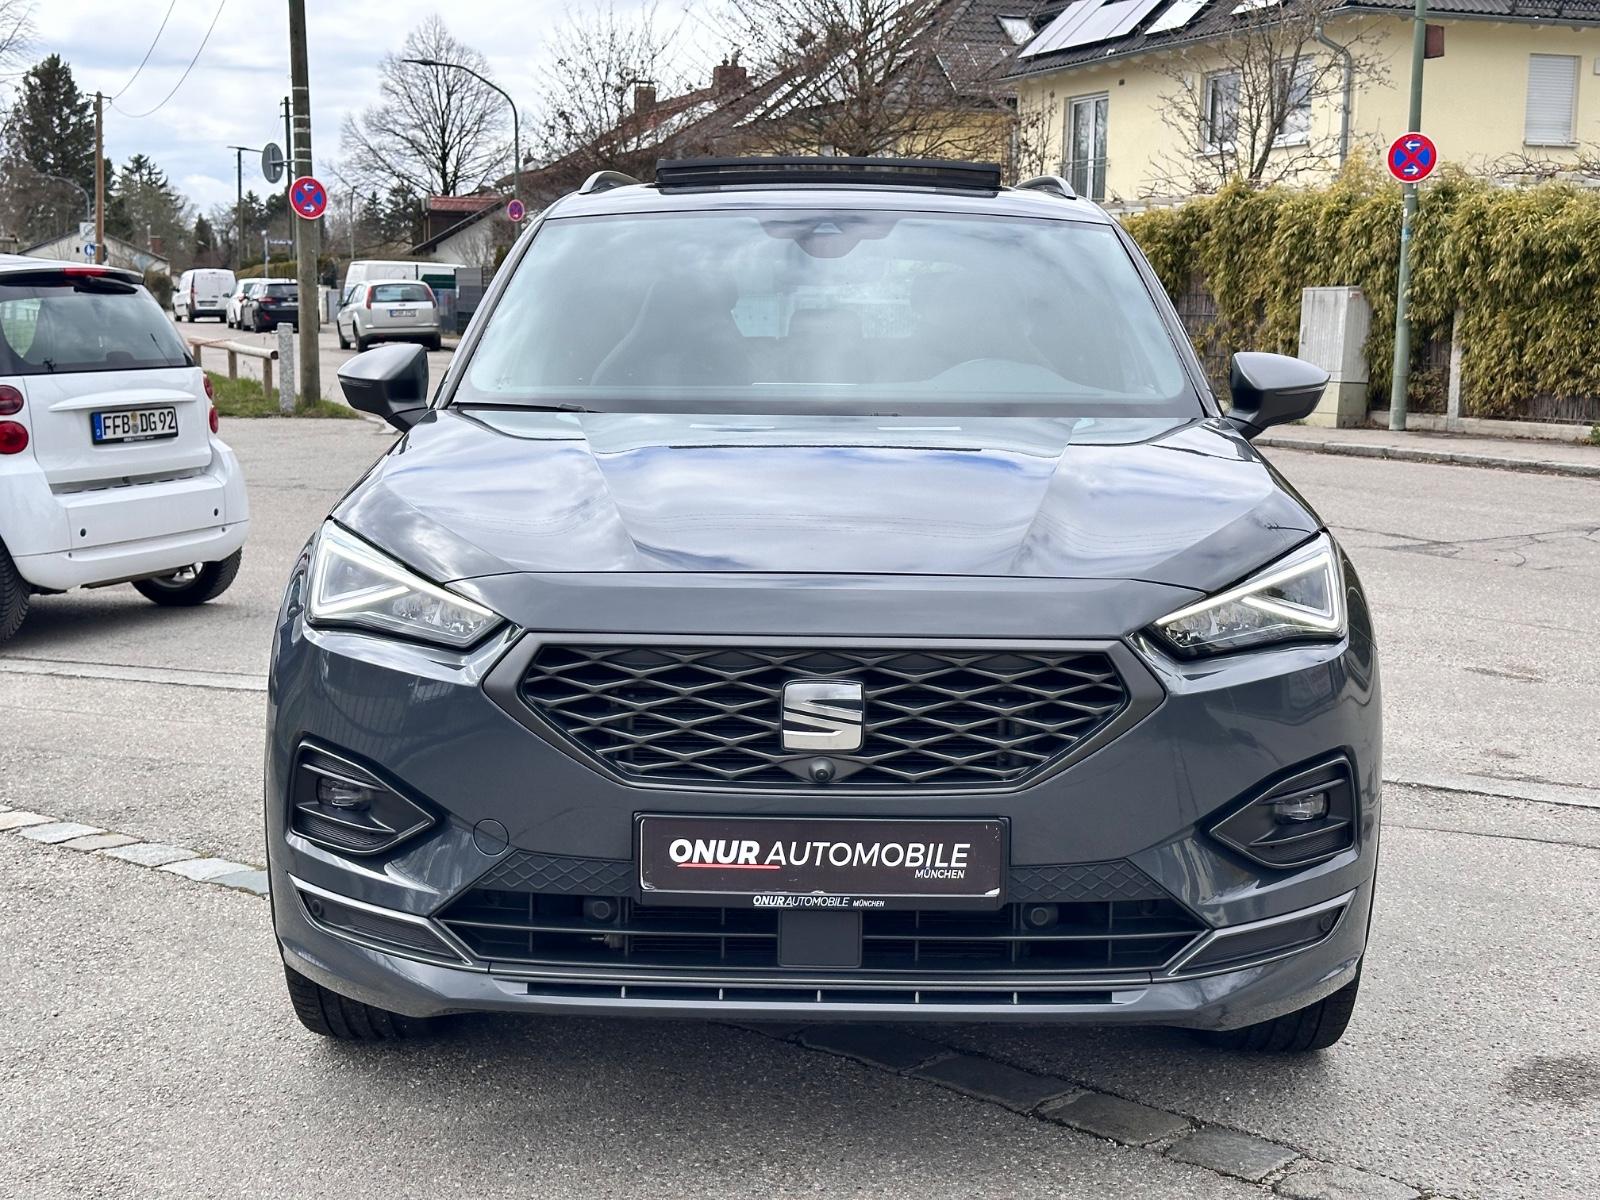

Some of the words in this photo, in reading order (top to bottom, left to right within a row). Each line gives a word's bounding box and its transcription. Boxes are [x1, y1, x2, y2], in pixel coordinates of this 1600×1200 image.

[103, 415, 131, 435] FFB
[140, 413, 157, 432] DG
[159, 411, 176, 430] 92
[669, 838, 760, 865] ONUR
[764, 841, 971, 867] AUTOMOBILE
[915, 867, 965, 879] MÜNCHEN
[853, 899, 885, 907] MÜNCHEN
